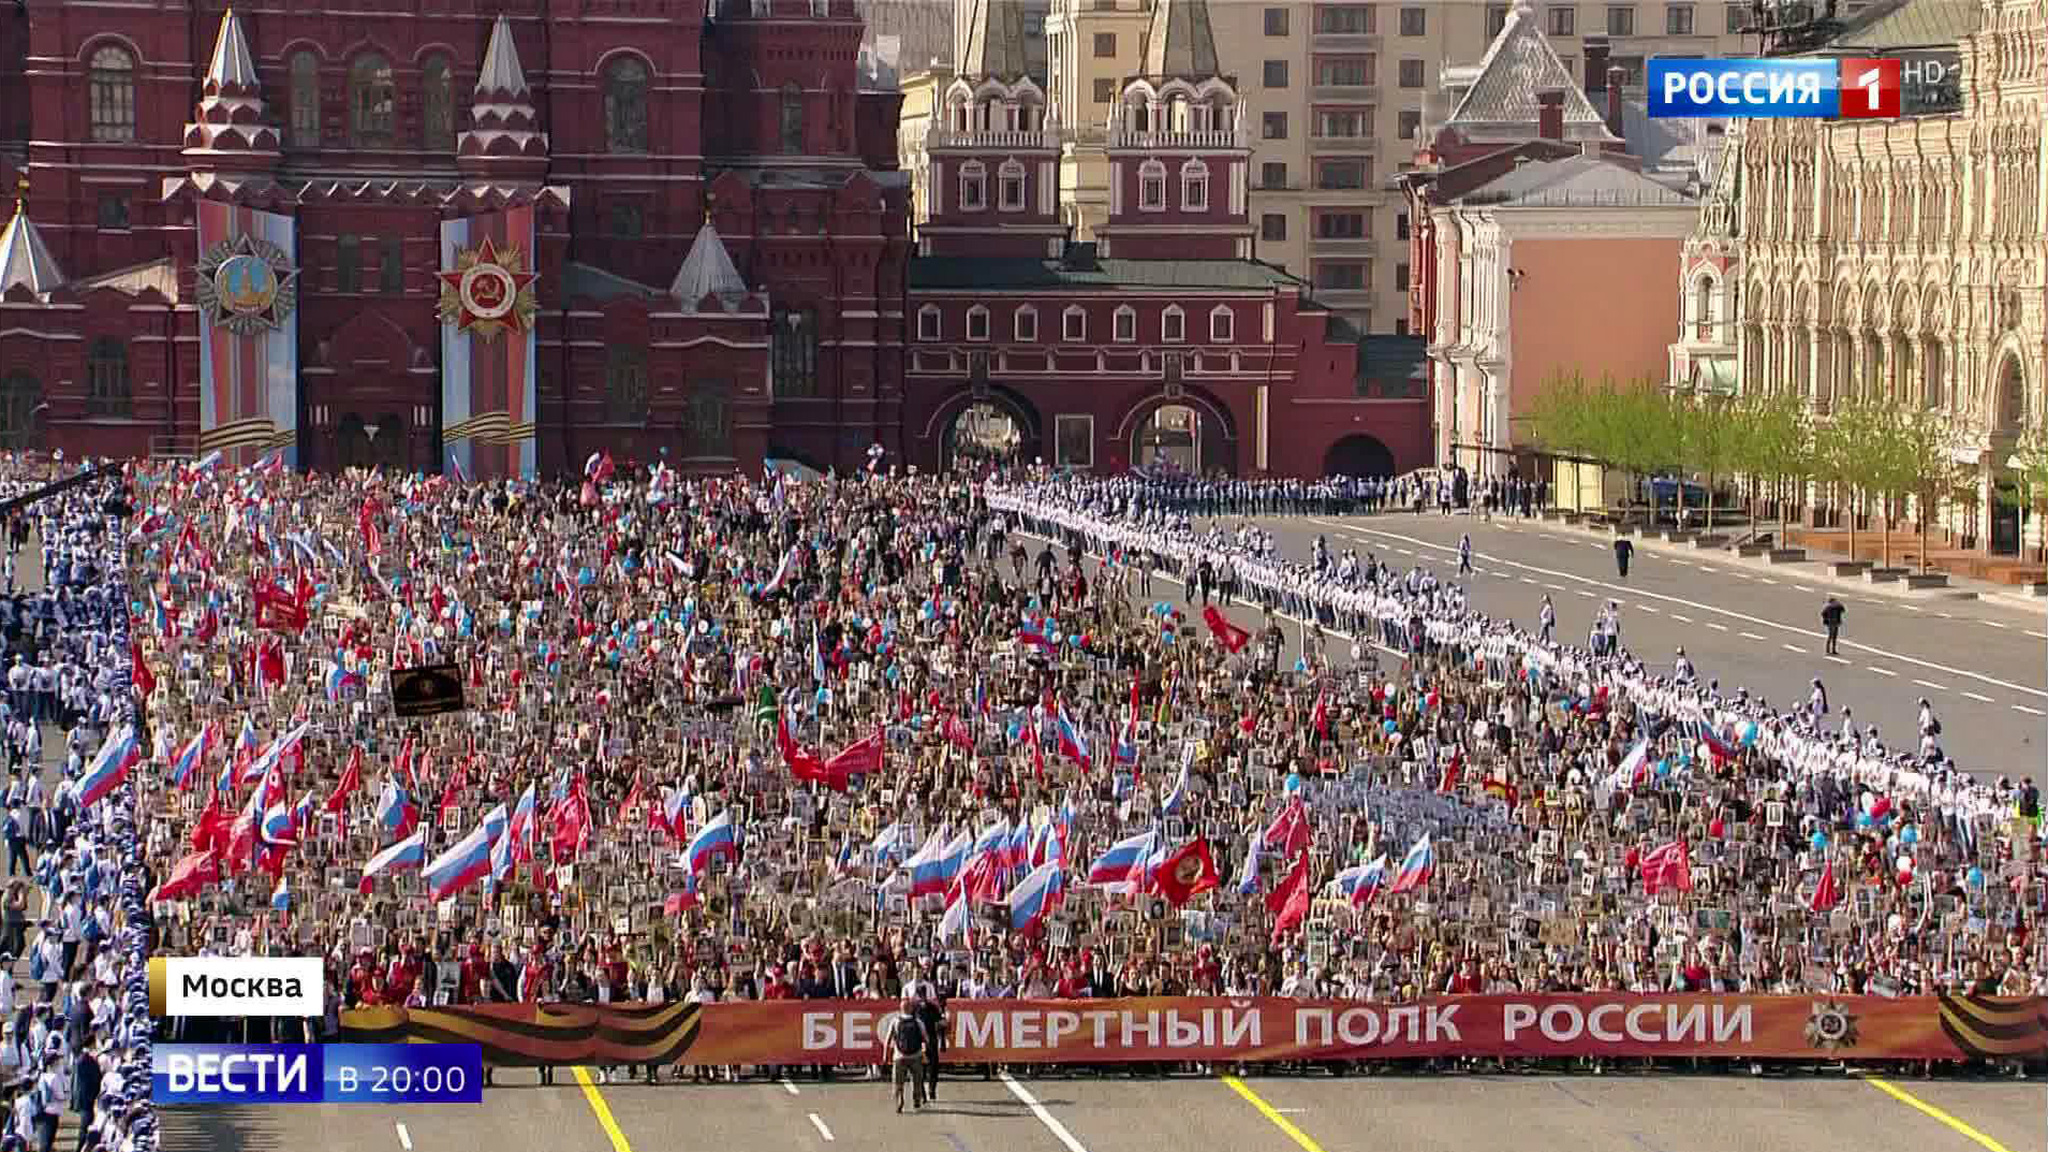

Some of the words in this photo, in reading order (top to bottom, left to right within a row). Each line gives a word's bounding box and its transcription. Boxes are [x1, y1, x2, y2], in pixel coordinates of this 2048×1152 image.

[802, 1000, 1262, 1051] БЕСМЕРТНЫЙ
[1295, 1004, 1462, 1047] ПОЛК
[1503, 1004, 1753, 1042] РОССИИ
